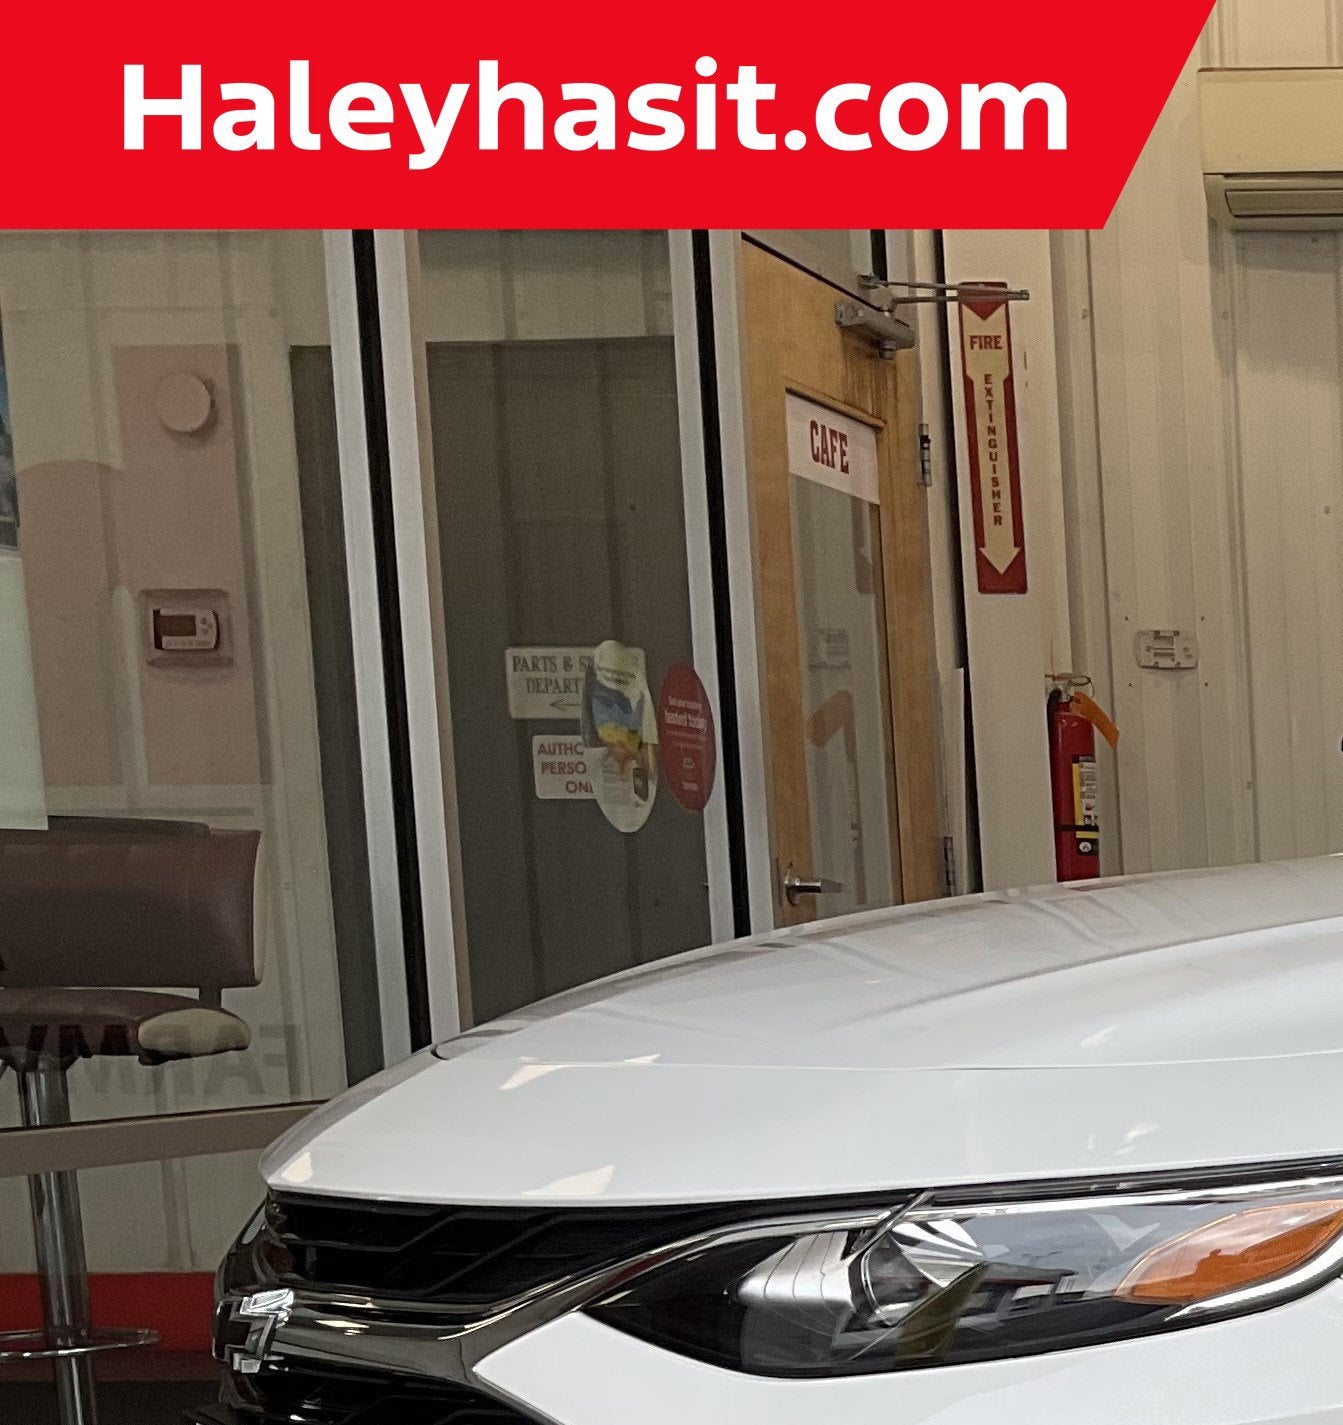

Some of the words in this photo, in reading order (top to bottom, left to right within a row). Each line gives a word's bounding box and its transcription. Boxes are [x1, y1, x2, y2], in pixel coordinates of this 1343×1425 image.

[969, 334, 1003, 350] FIRE
[810, 419, 849, 475] CAFE
[983, 373, 1003, 526] EXTINGUISHER
[512, 655, 557, 673] PARTS
[526, 677, 583, 694] DEPART
[541, 761, 587, 775] PERSO
